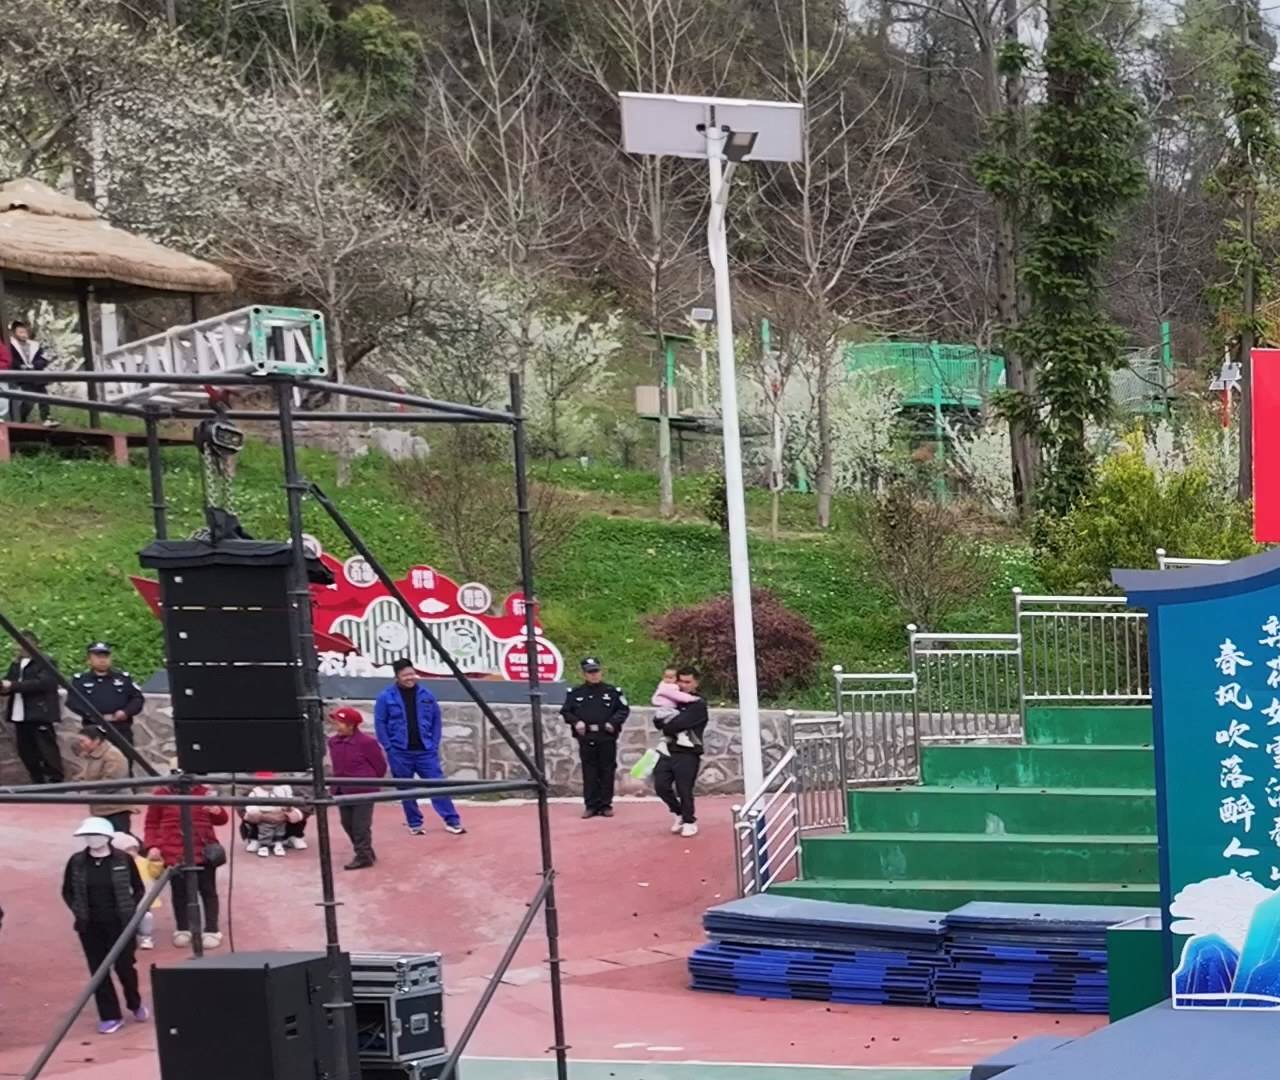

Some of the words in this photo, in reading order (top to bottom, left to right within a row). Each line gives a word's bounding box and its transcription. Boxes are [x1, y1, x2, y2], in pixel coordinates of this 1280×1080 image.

[1215, 638, 1259, 882] 春风吹落醉人
